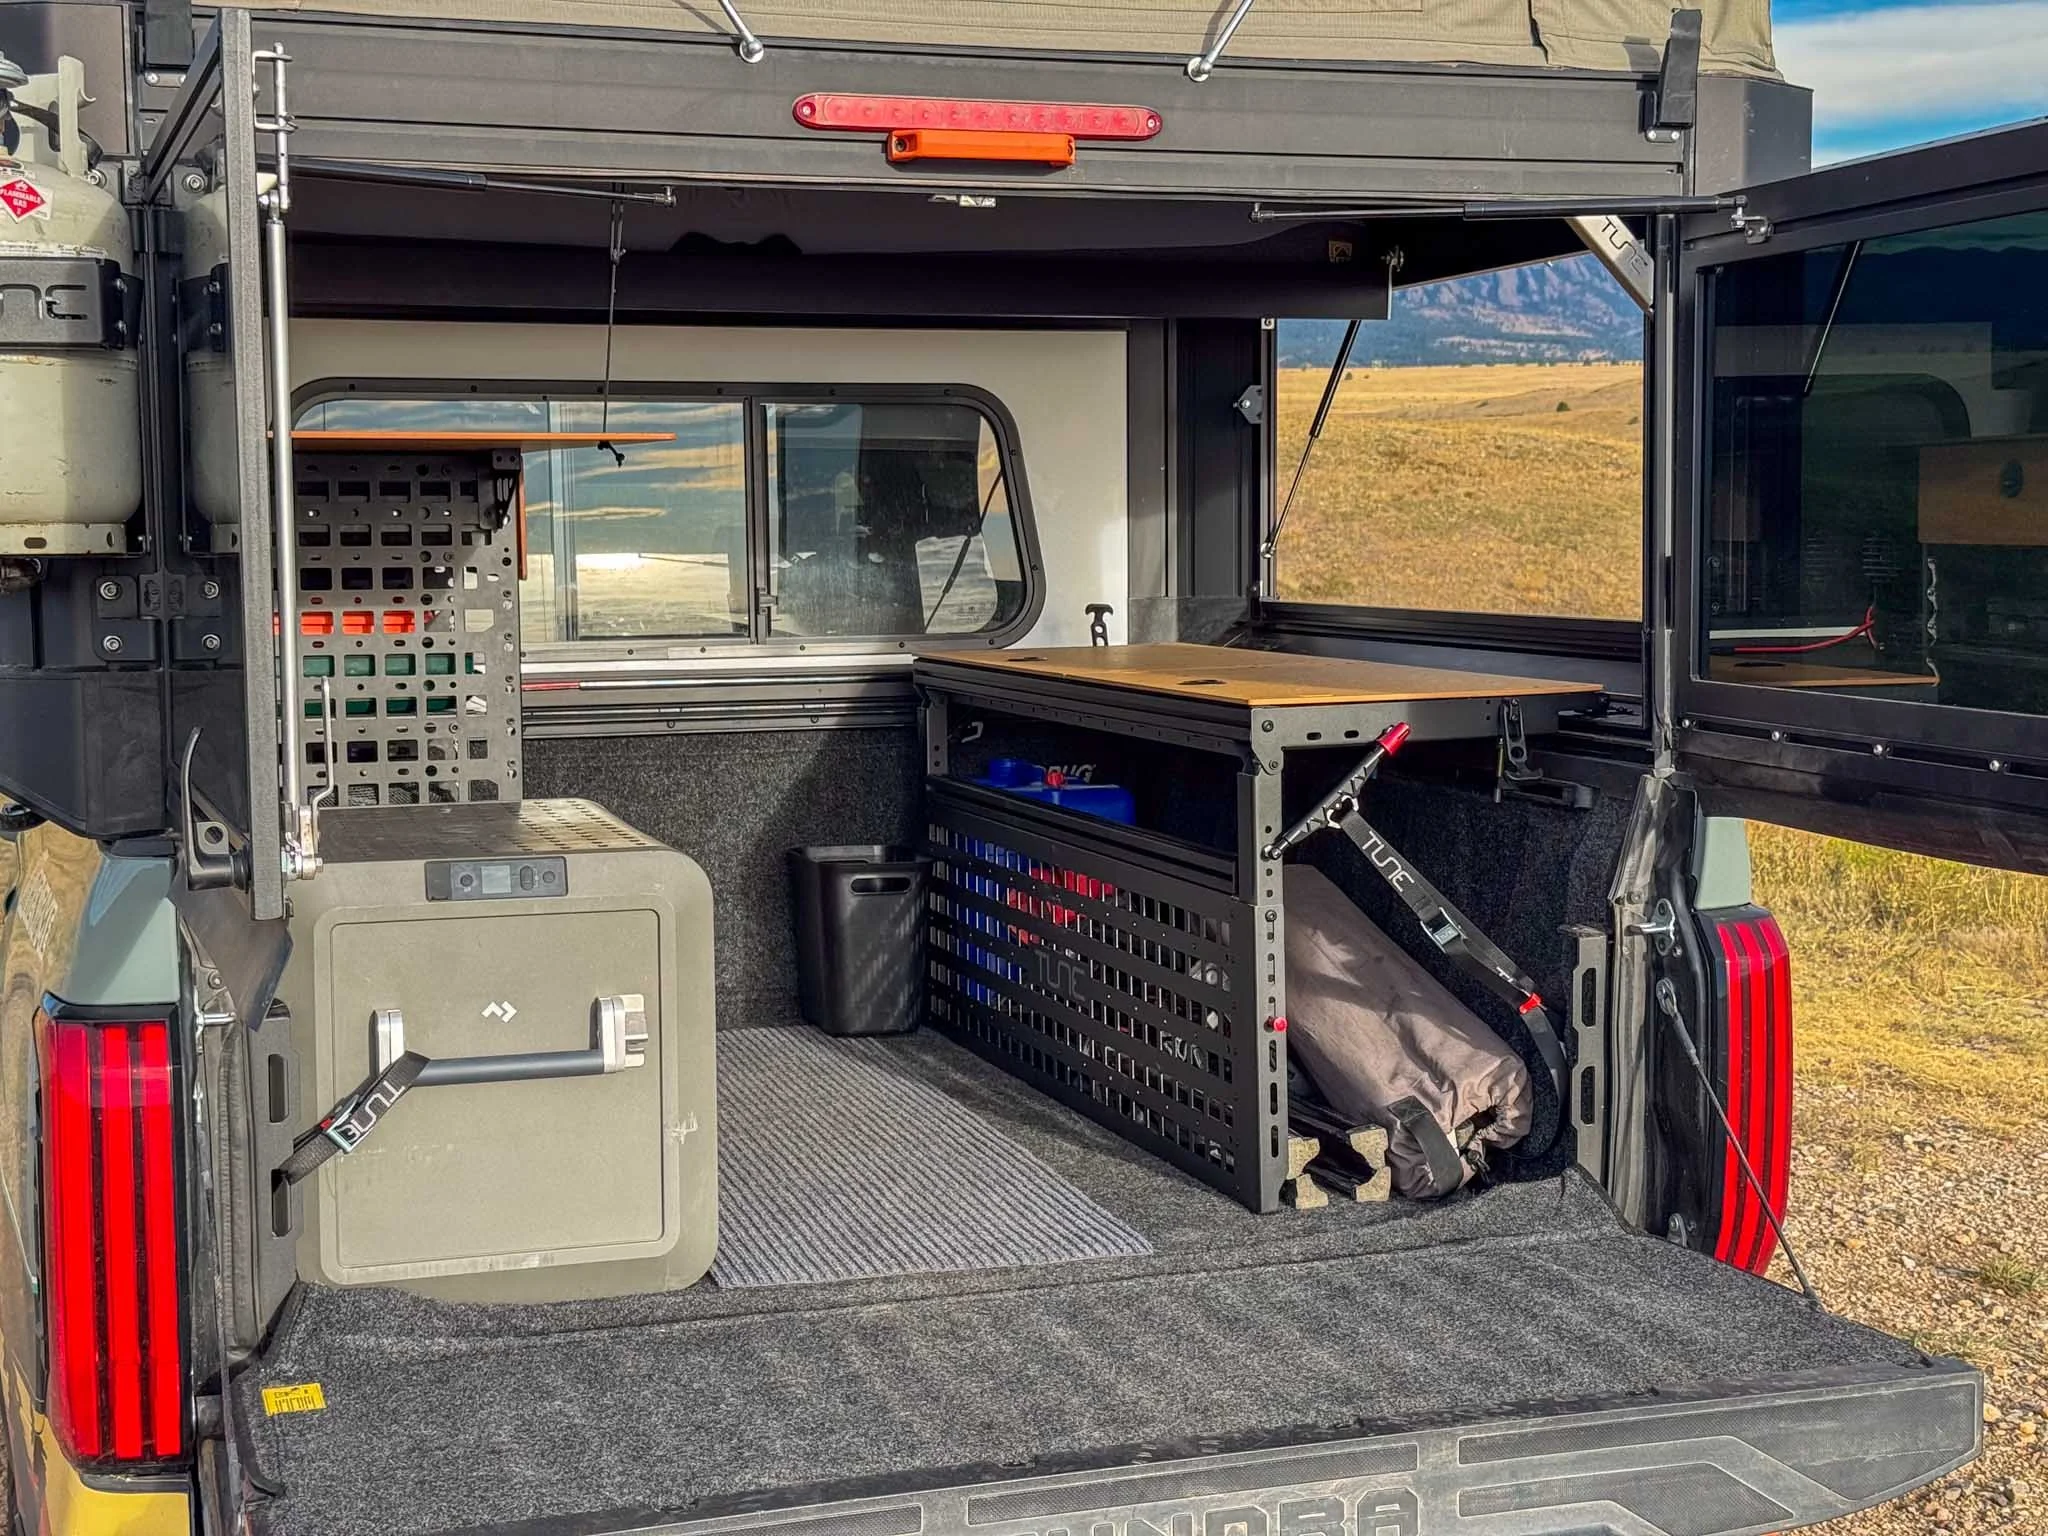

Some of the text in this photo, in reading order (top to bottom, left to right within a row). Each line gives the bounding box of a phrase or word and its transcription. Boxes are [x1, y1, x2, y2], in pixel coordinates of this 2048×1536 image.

[1601, 215, 1648, 275] TUNE
[1362, 831, 1415, 892] TUNE
[1033, 949, 1086, 1002] TUNE
[335, 1080, 406, 1144] TUNE
